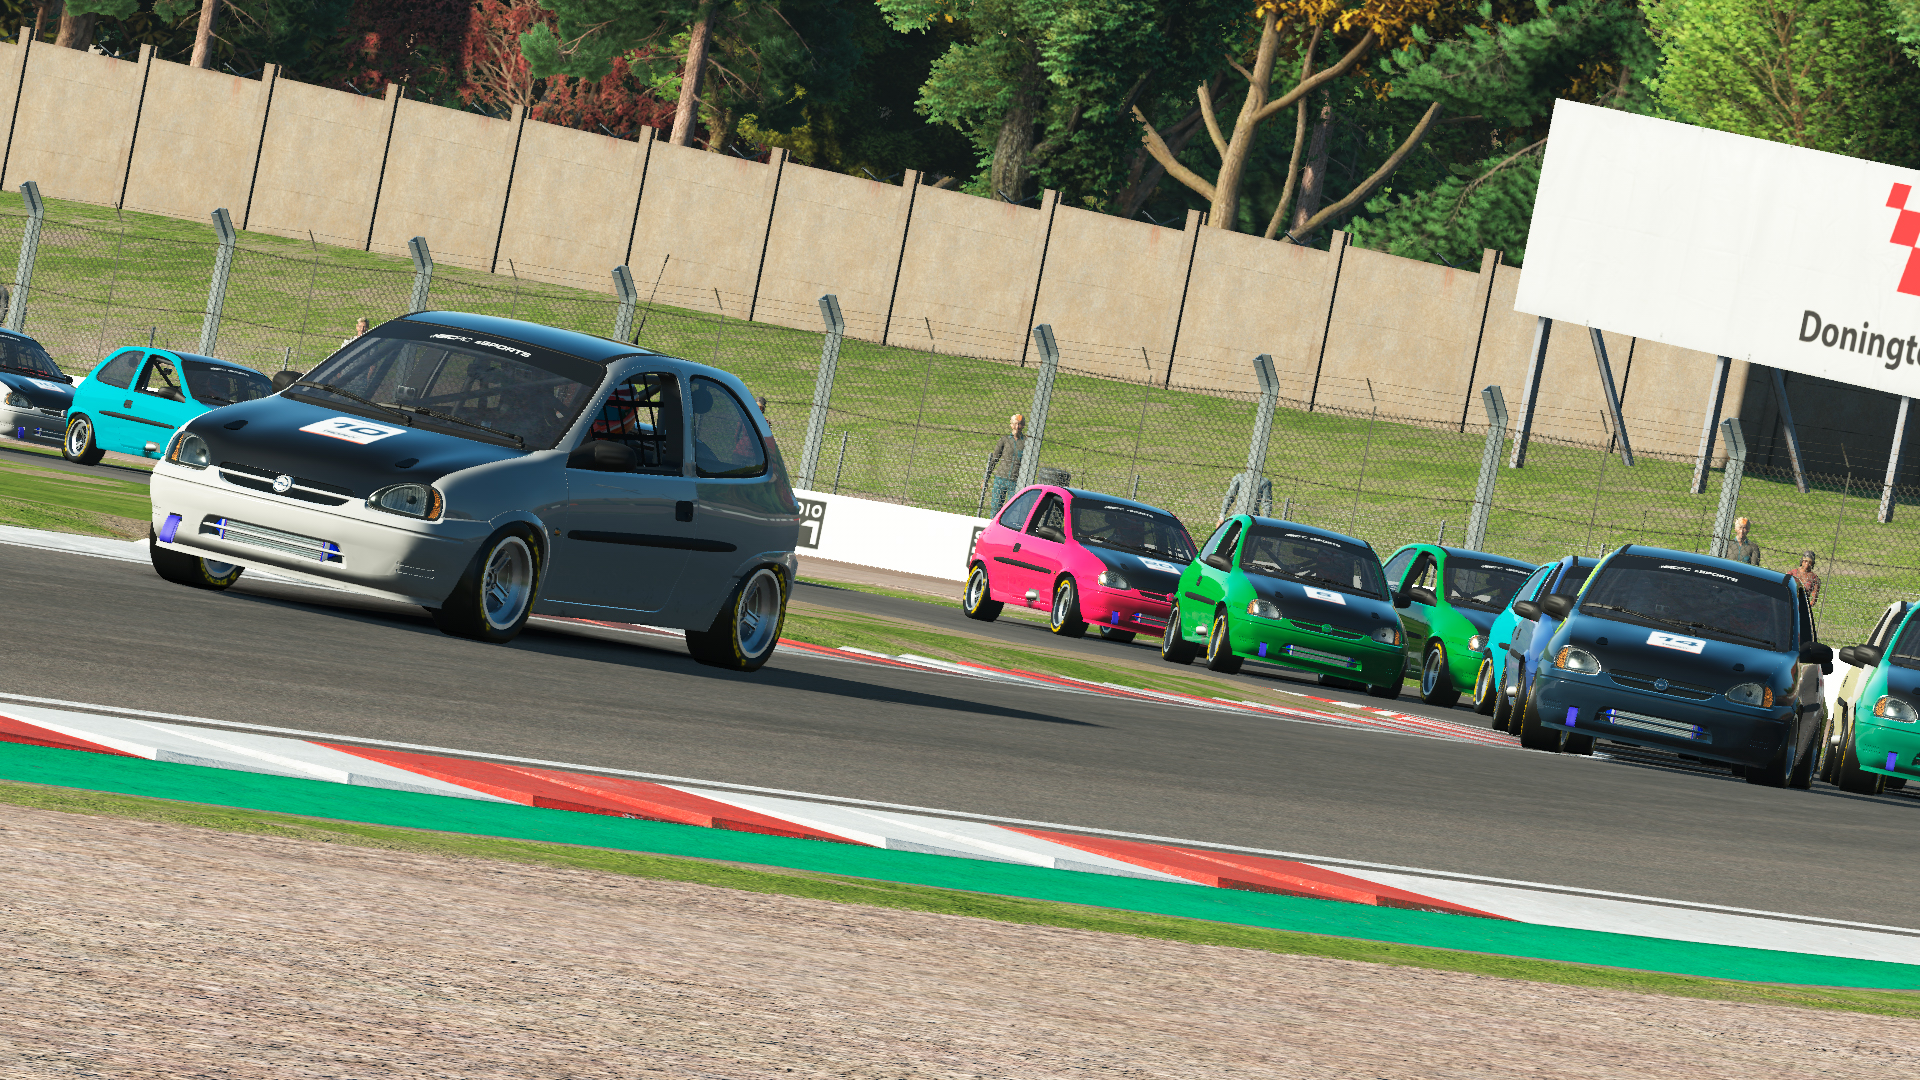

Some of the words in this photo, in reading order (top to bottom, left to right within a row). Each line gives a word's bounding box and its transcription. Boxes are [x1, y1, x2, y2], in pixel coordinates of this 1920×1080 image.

[1799, 310, 1920, 370] Doningt
[333, 422, 389, 436] 10
[1659, 636, 1698, 647] 14
